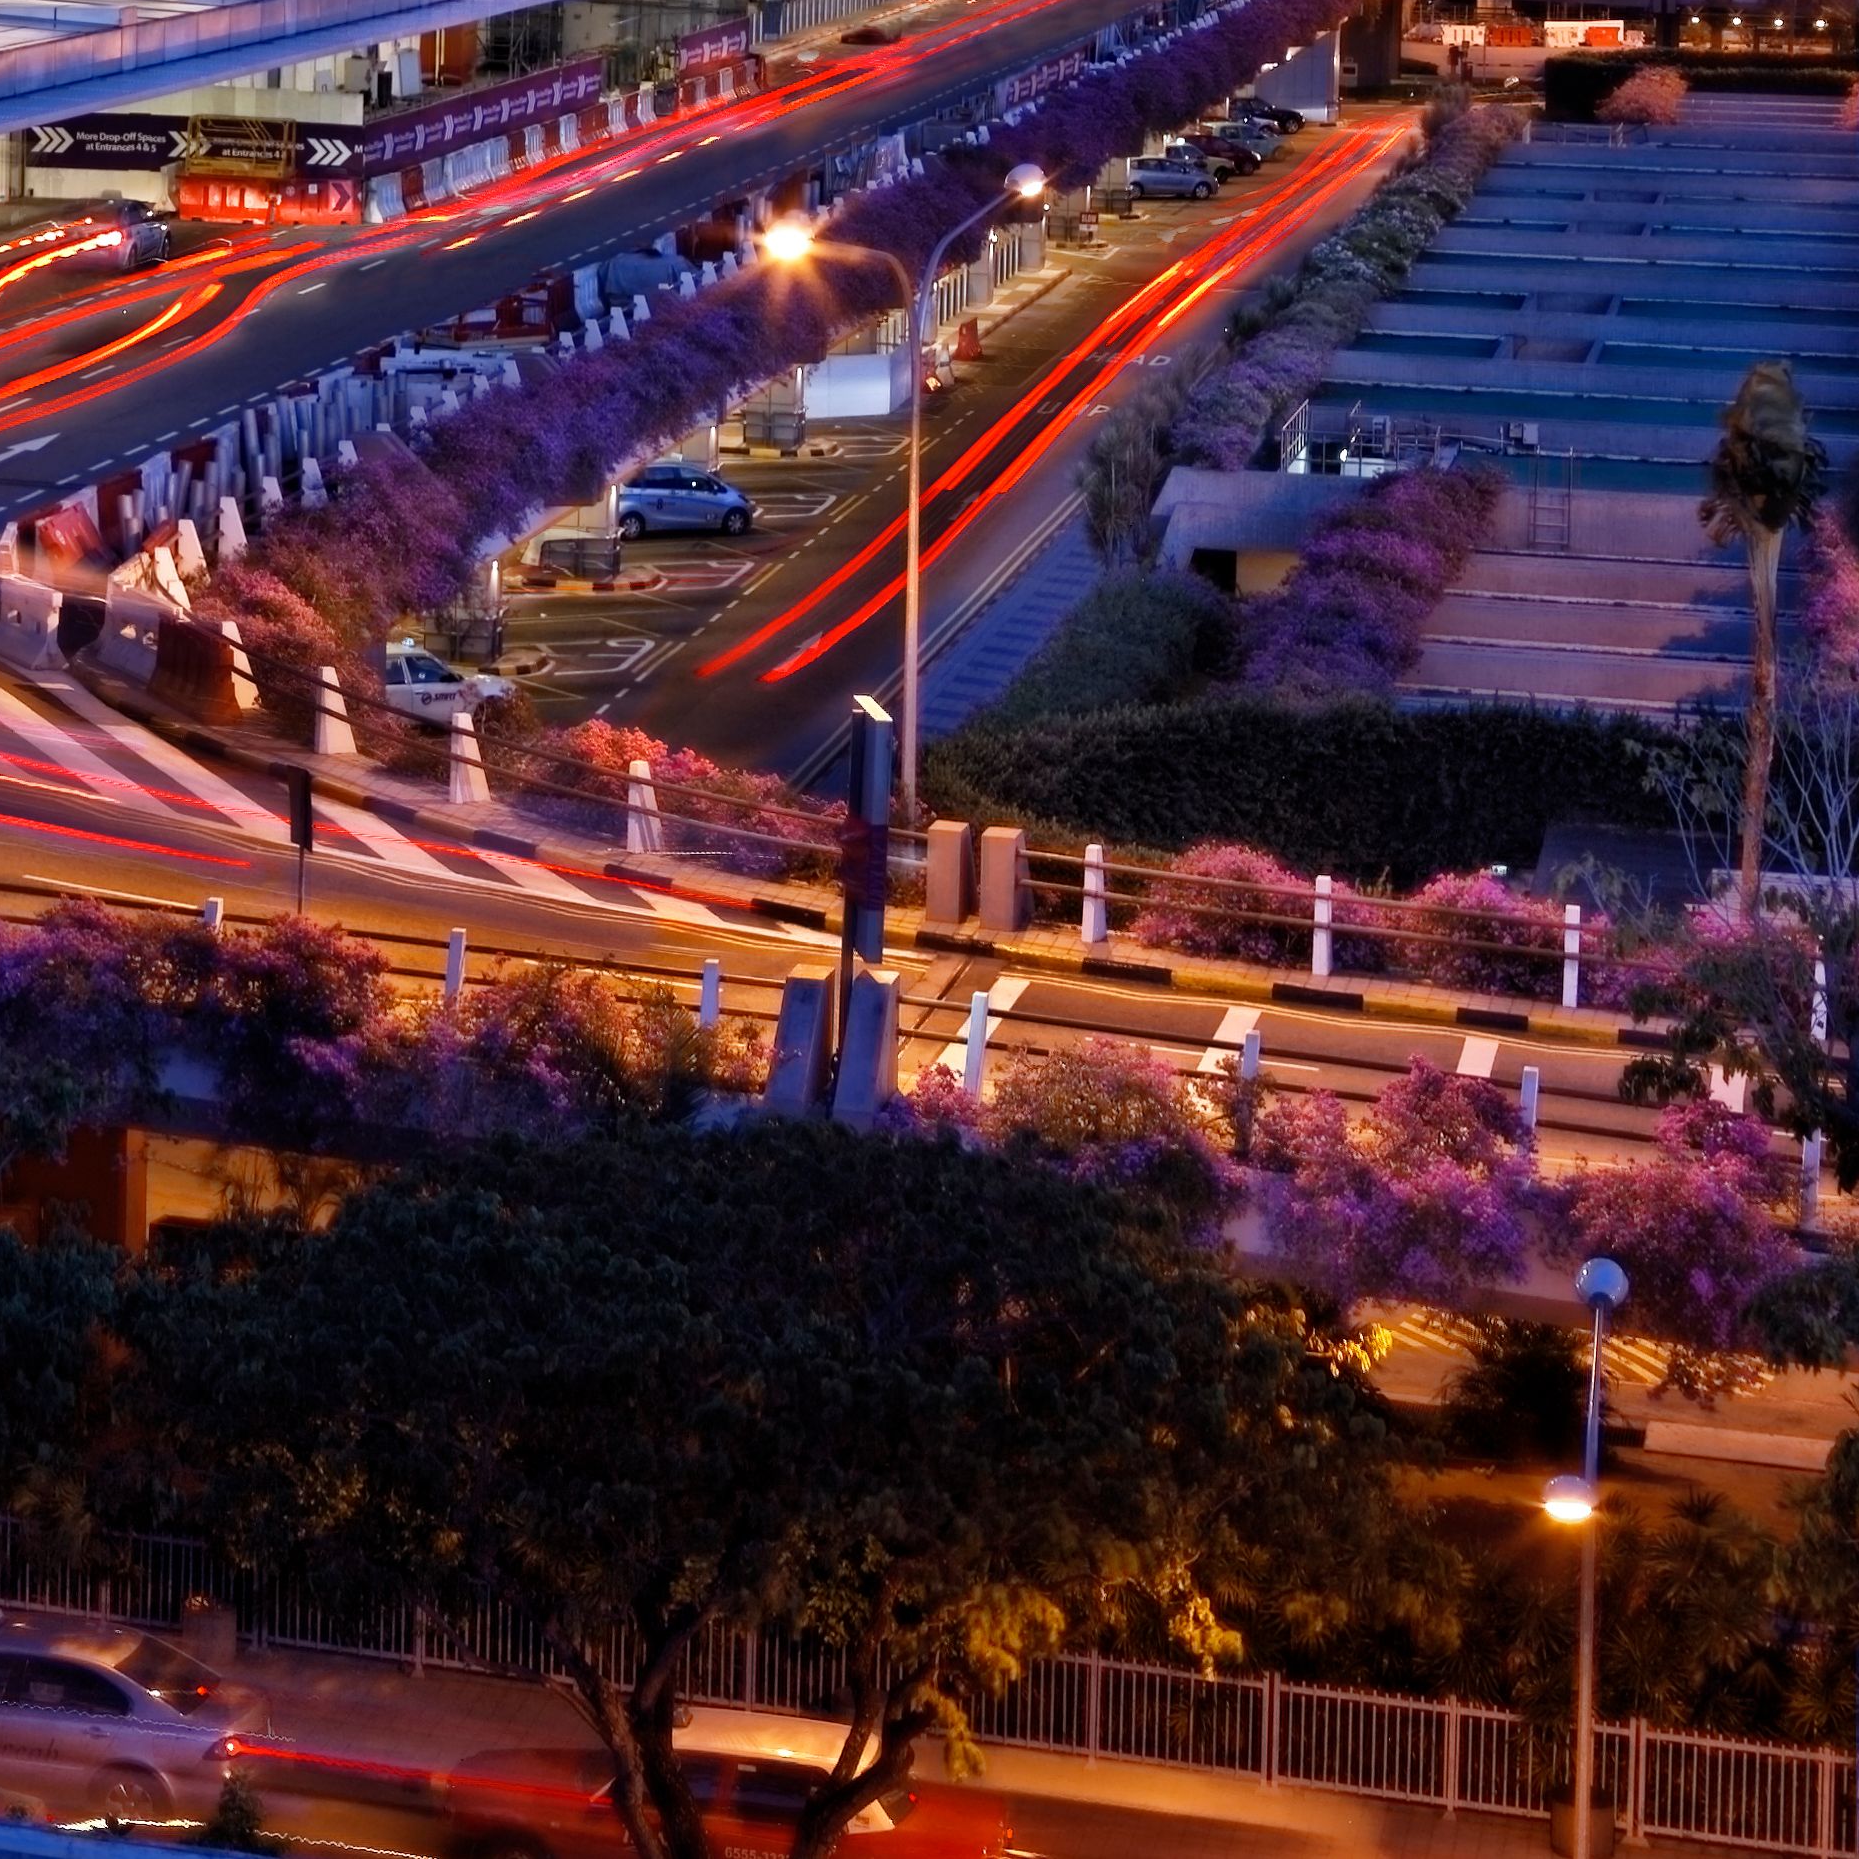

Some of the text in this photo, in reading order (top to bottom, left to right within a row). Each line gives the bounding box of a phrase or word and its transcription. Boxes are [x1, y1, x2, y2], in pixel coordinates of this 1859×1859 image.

[76, 131, 167, 143] More Drop-Off Spaces
[85, 142, 94, 150] at
[95, 143, 135, 151] Entrances
[142, 144, 150, 152] &
[151, 144, 157, 152] 5
